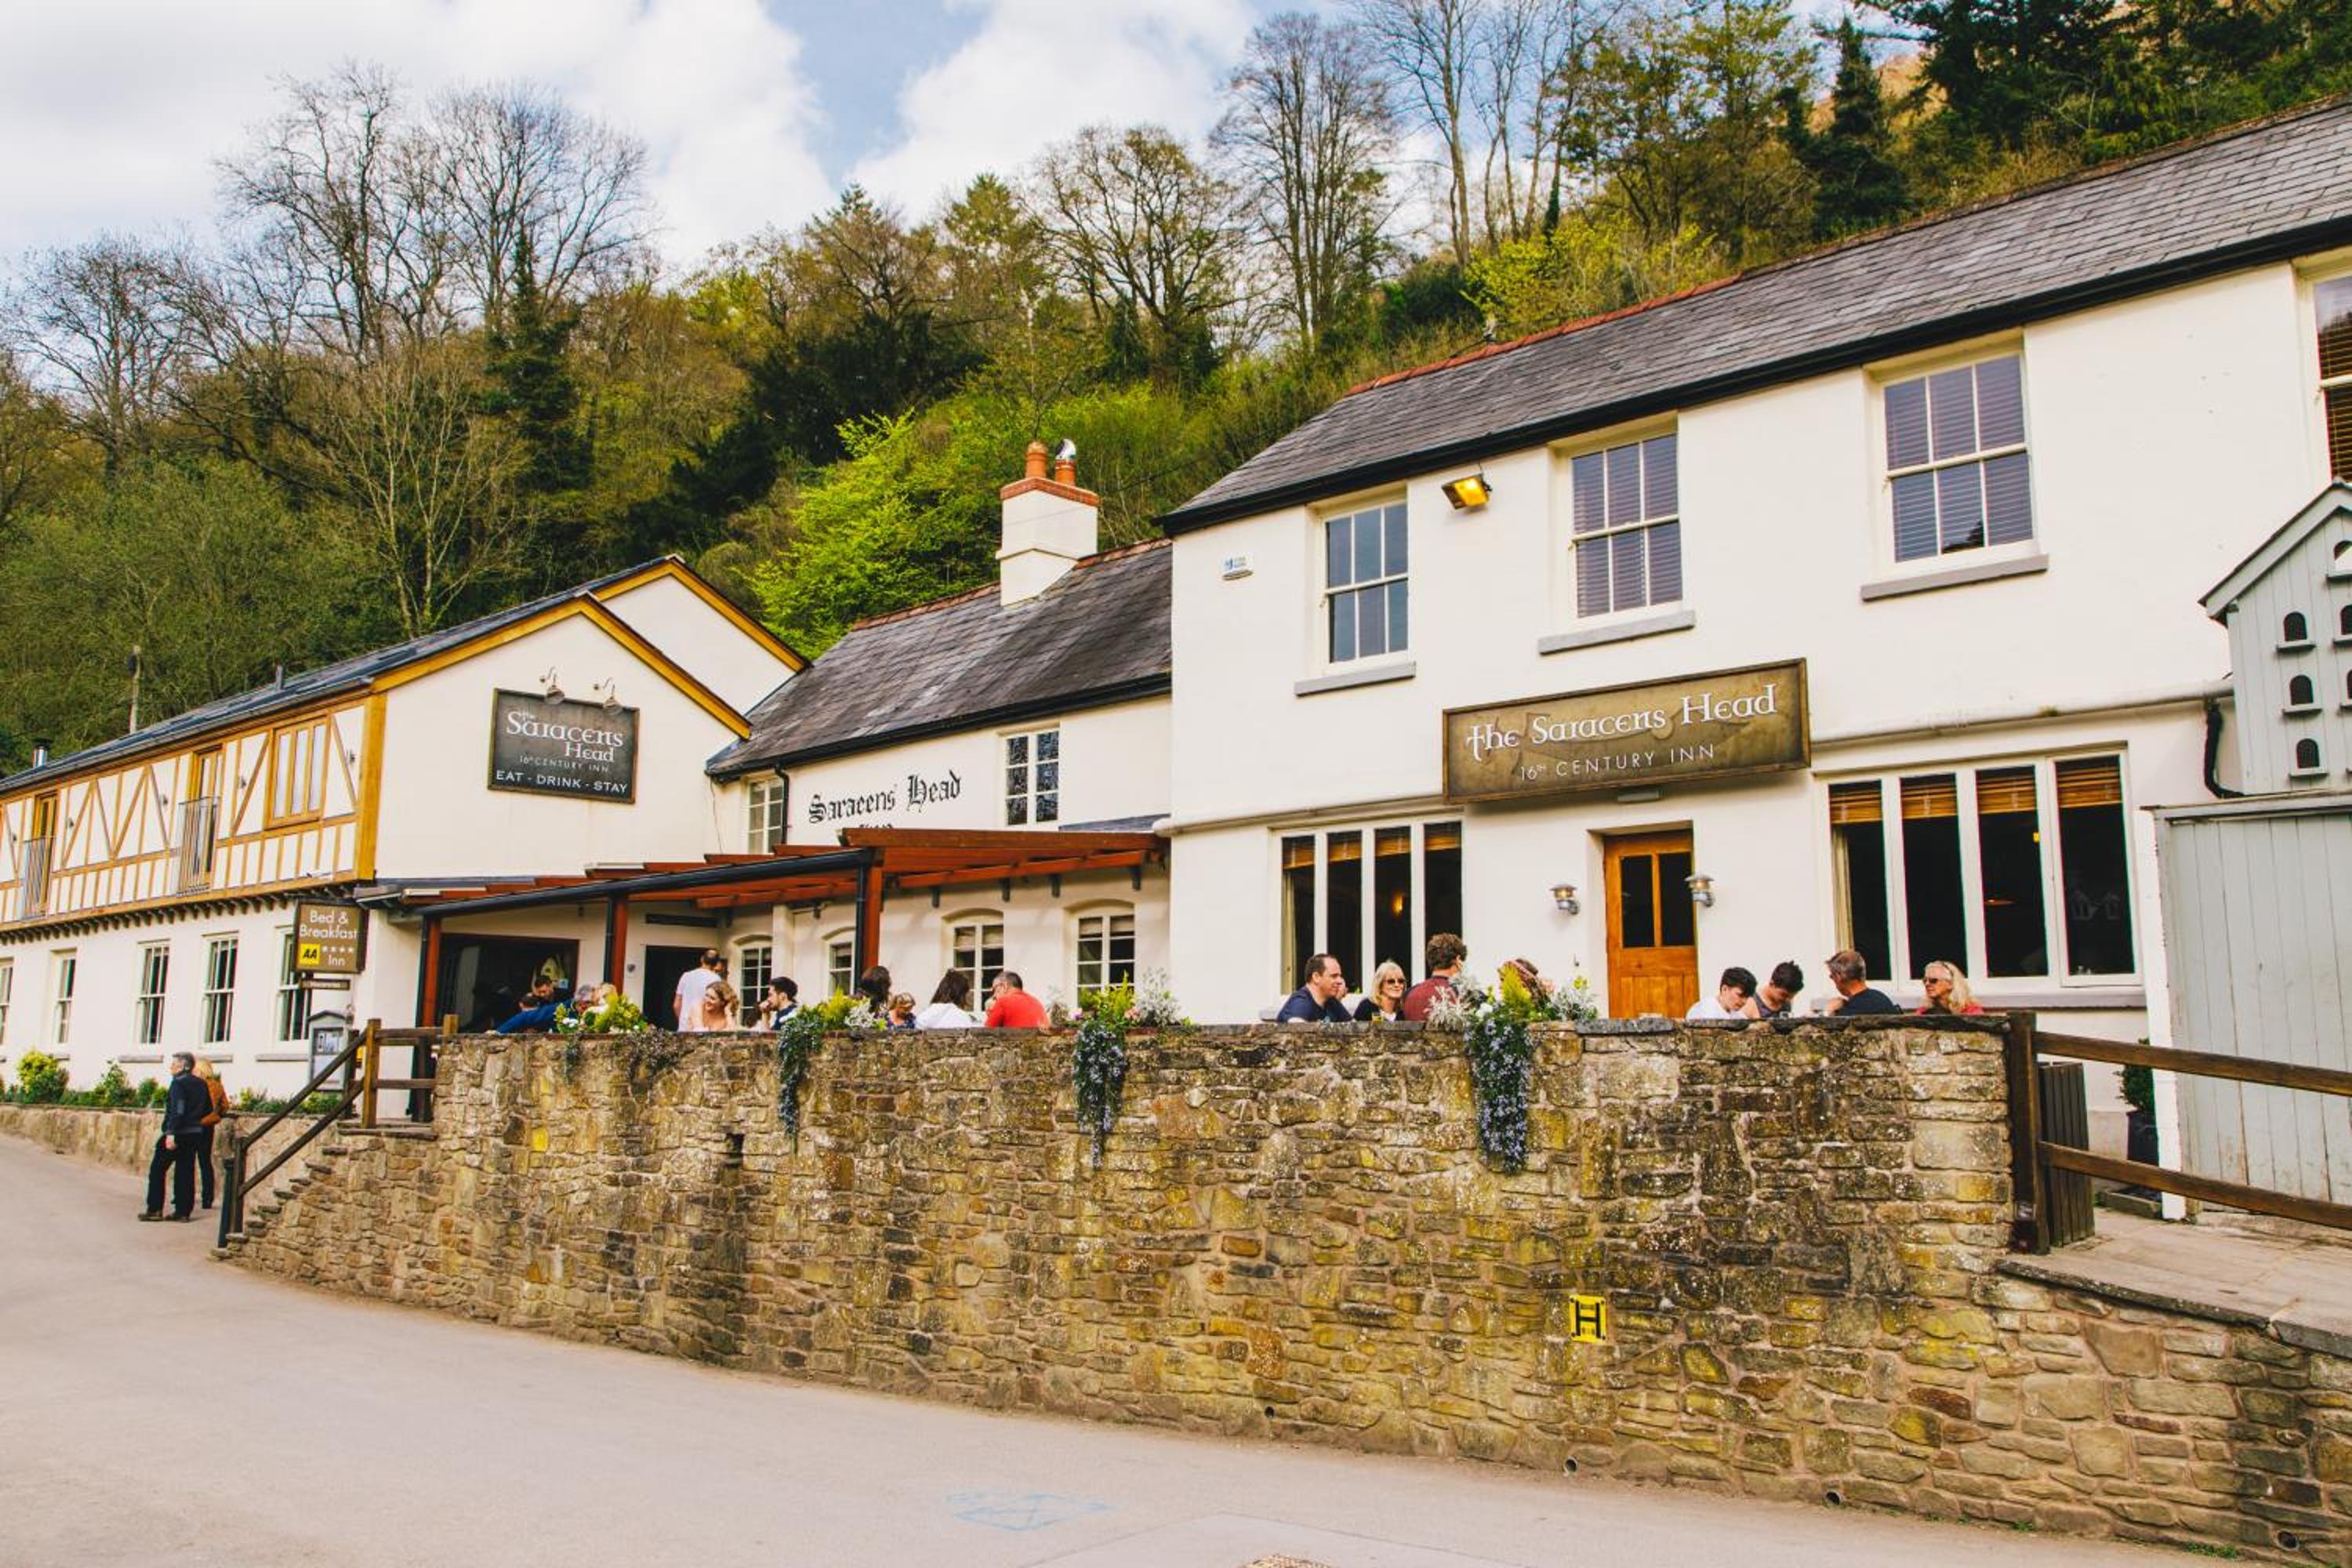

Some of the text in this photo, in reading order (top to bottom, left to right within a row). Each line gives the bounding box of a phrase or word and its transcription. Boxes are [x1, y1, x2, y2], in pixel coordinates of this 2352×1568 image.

[1531, 709, 1666, 745] Saracens
[1682, 684, 1777, 726] Head
[506, 711, 624, 747] Saracens
[564, 742, 615, 762] Head
[1556, 750, 1655, 776] CENTURY
[1670, 743, 1715, 764] INN
[535, 757, 583, 769] CENTURY
[589, 764, 609, 773] INN
[496, 770, 524, 782] EAT
[537, 775, 581, 789] DRINK
[593, 780, 627, 793] STAY
[906, 769, 961, 812] Head
[310, 909, 349, 924] Bed &
[299, 924, 358, 939] Breakfast
[303, 948, 318, 959] AA
[328, 954, 346, 967] Inn
[1575, 1300, 1601, 1338] H
